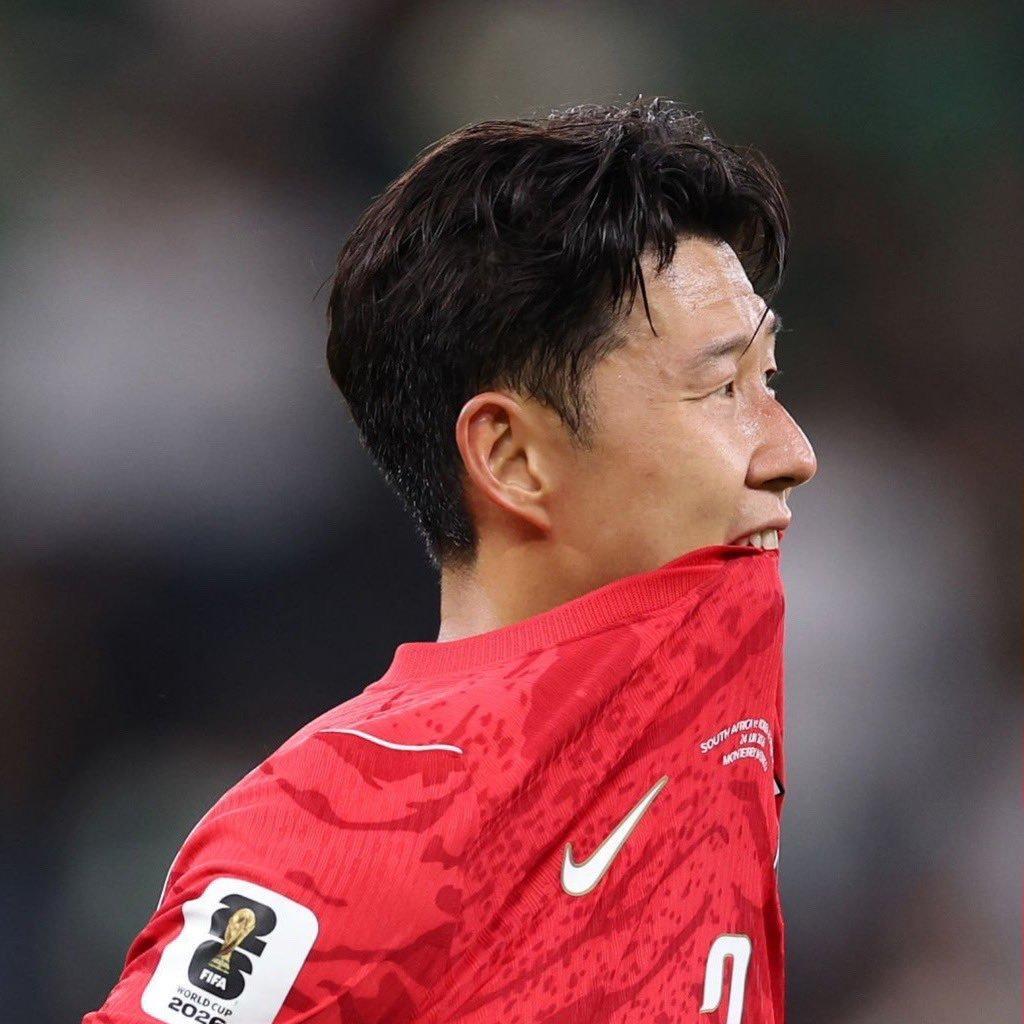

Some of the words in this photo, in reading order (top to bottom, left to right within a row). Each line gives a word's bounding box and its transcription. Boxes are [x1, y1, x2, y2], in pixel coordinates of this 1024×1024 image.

[700, 727, 731, 754] SOUTH
[199, 968, 228, 991] FIFA
[176, 985, 210, 1007] WORLD
[210, 1002, 233, 1018] CUP
